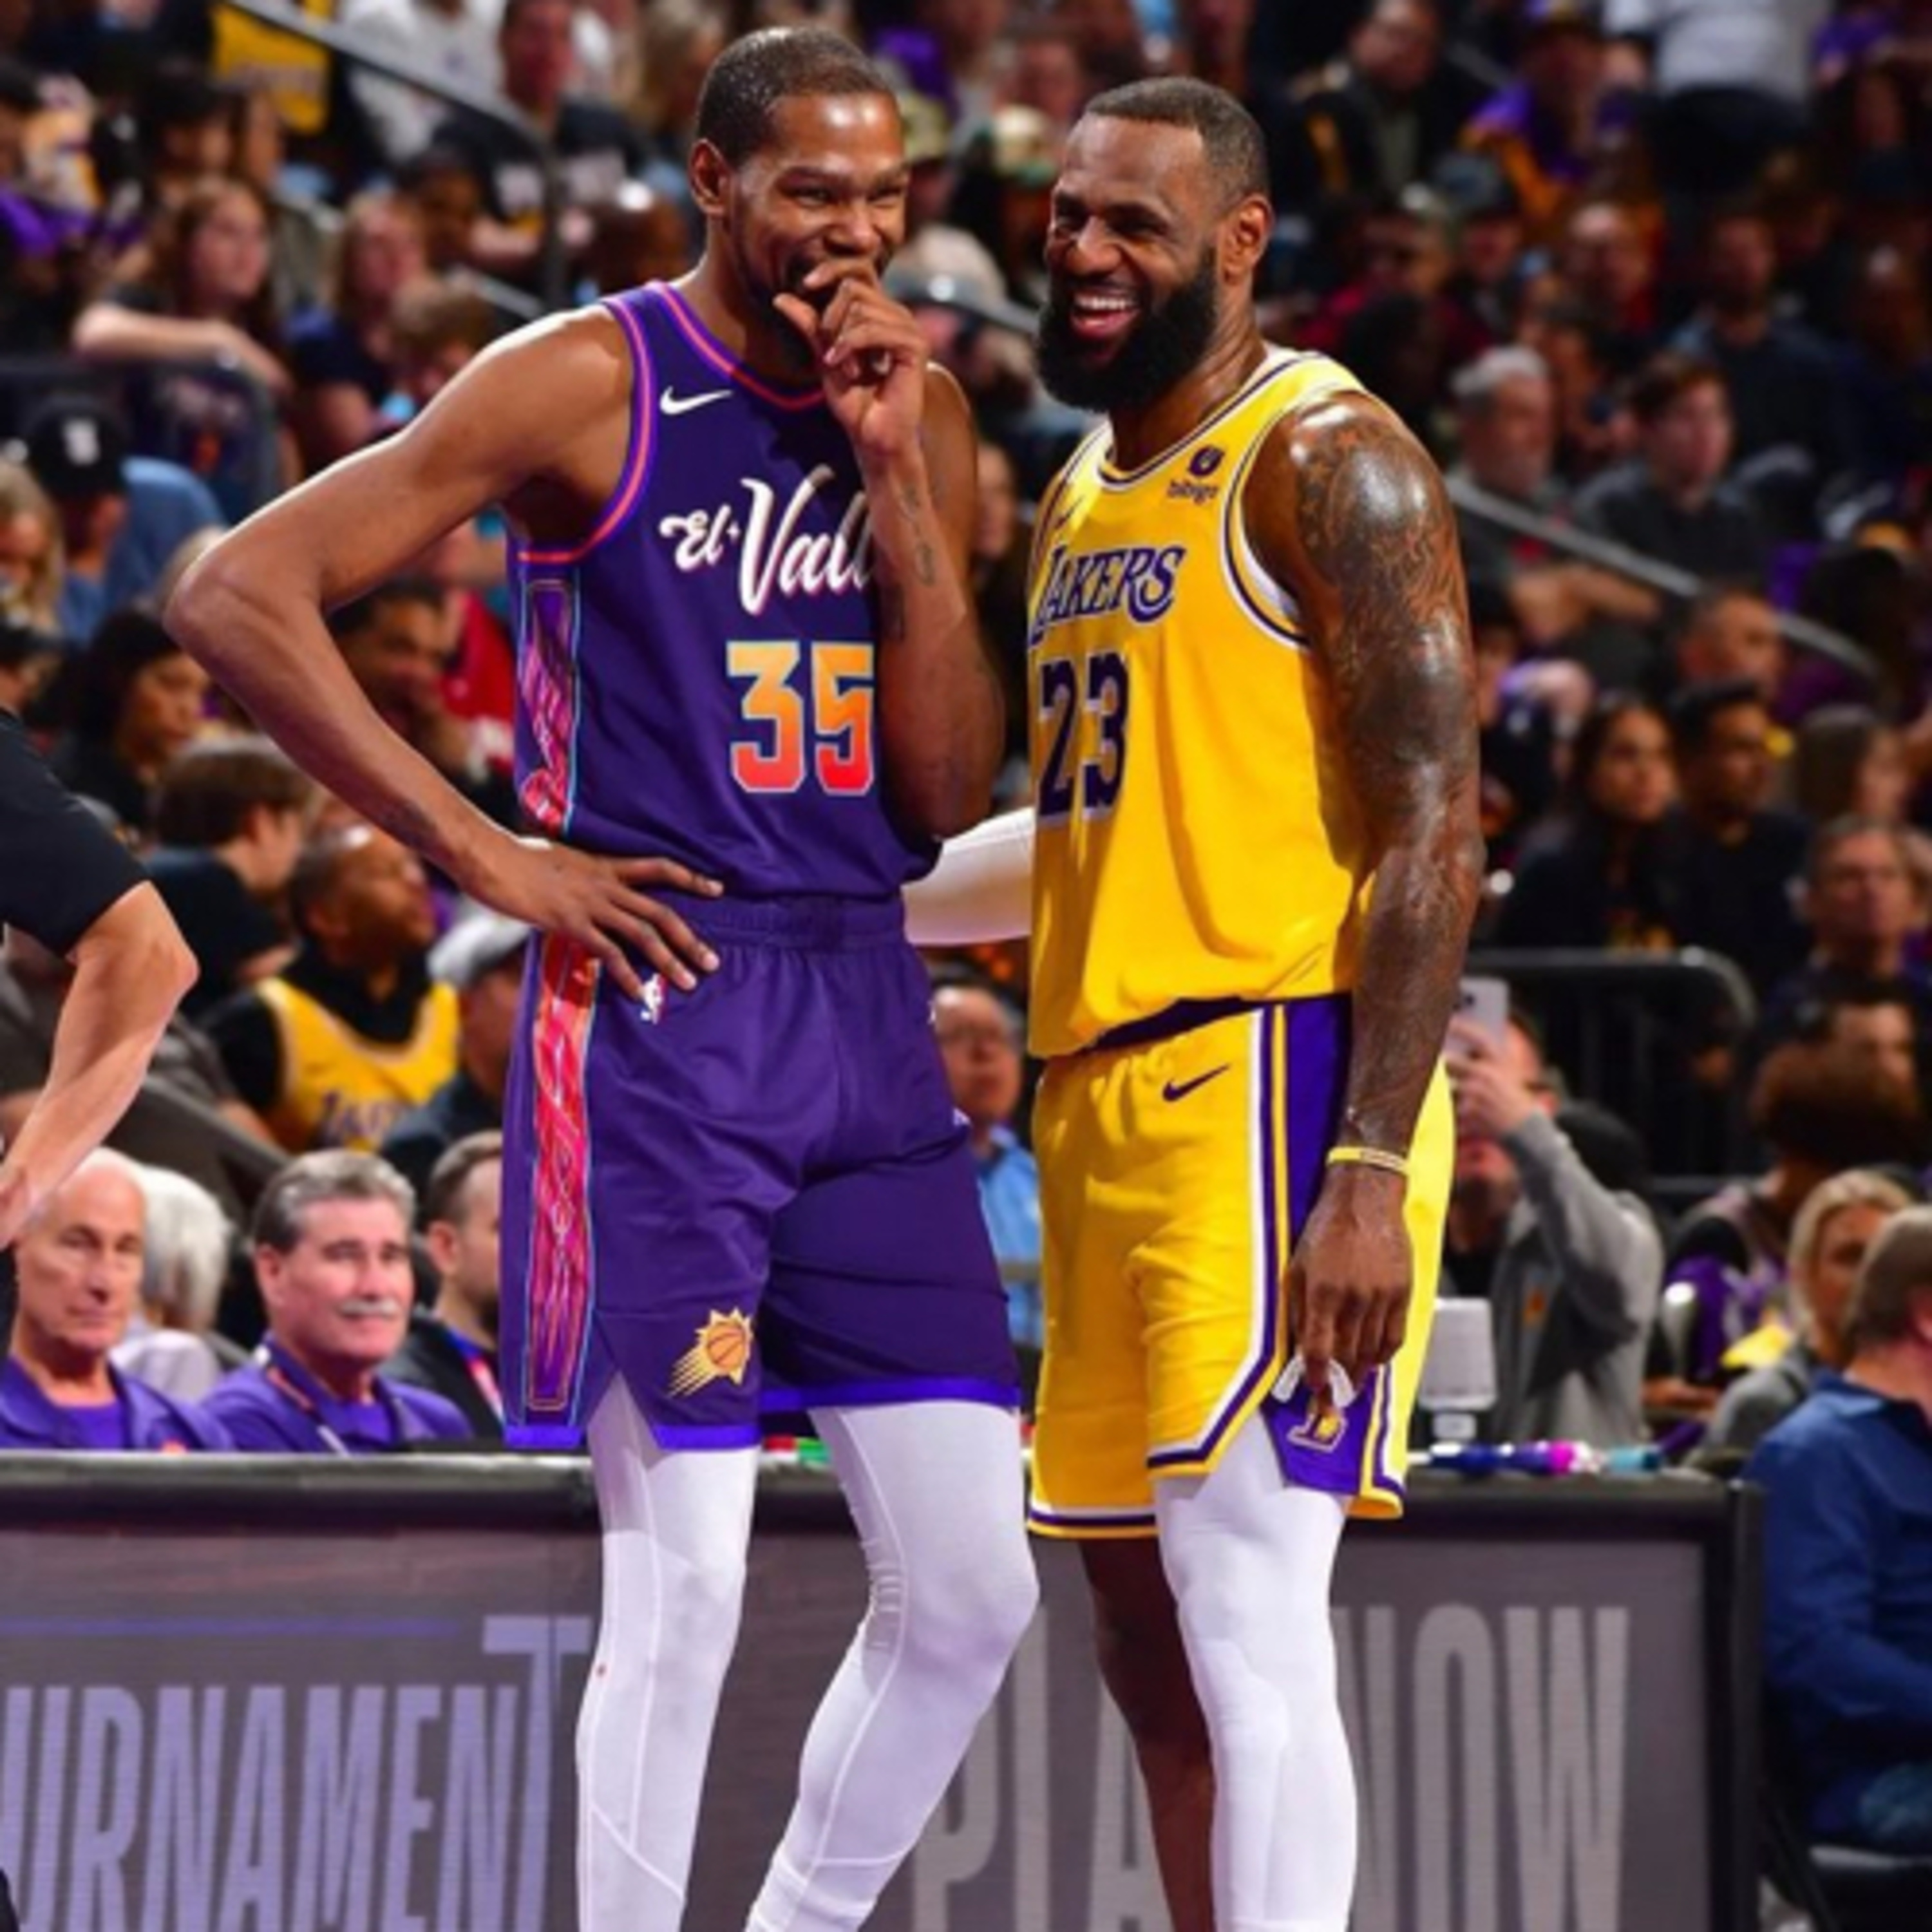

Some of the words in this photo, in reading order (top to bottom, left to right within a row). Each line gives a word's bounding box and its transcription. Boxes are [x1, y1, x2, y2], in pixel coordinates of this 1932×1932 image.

[737, 464, 875, 616] Vall
[1028, 544, 1187, 649] LAKERS
[726, 640, 875, 796] 35
[1037, 649, 1132, 822] 23
